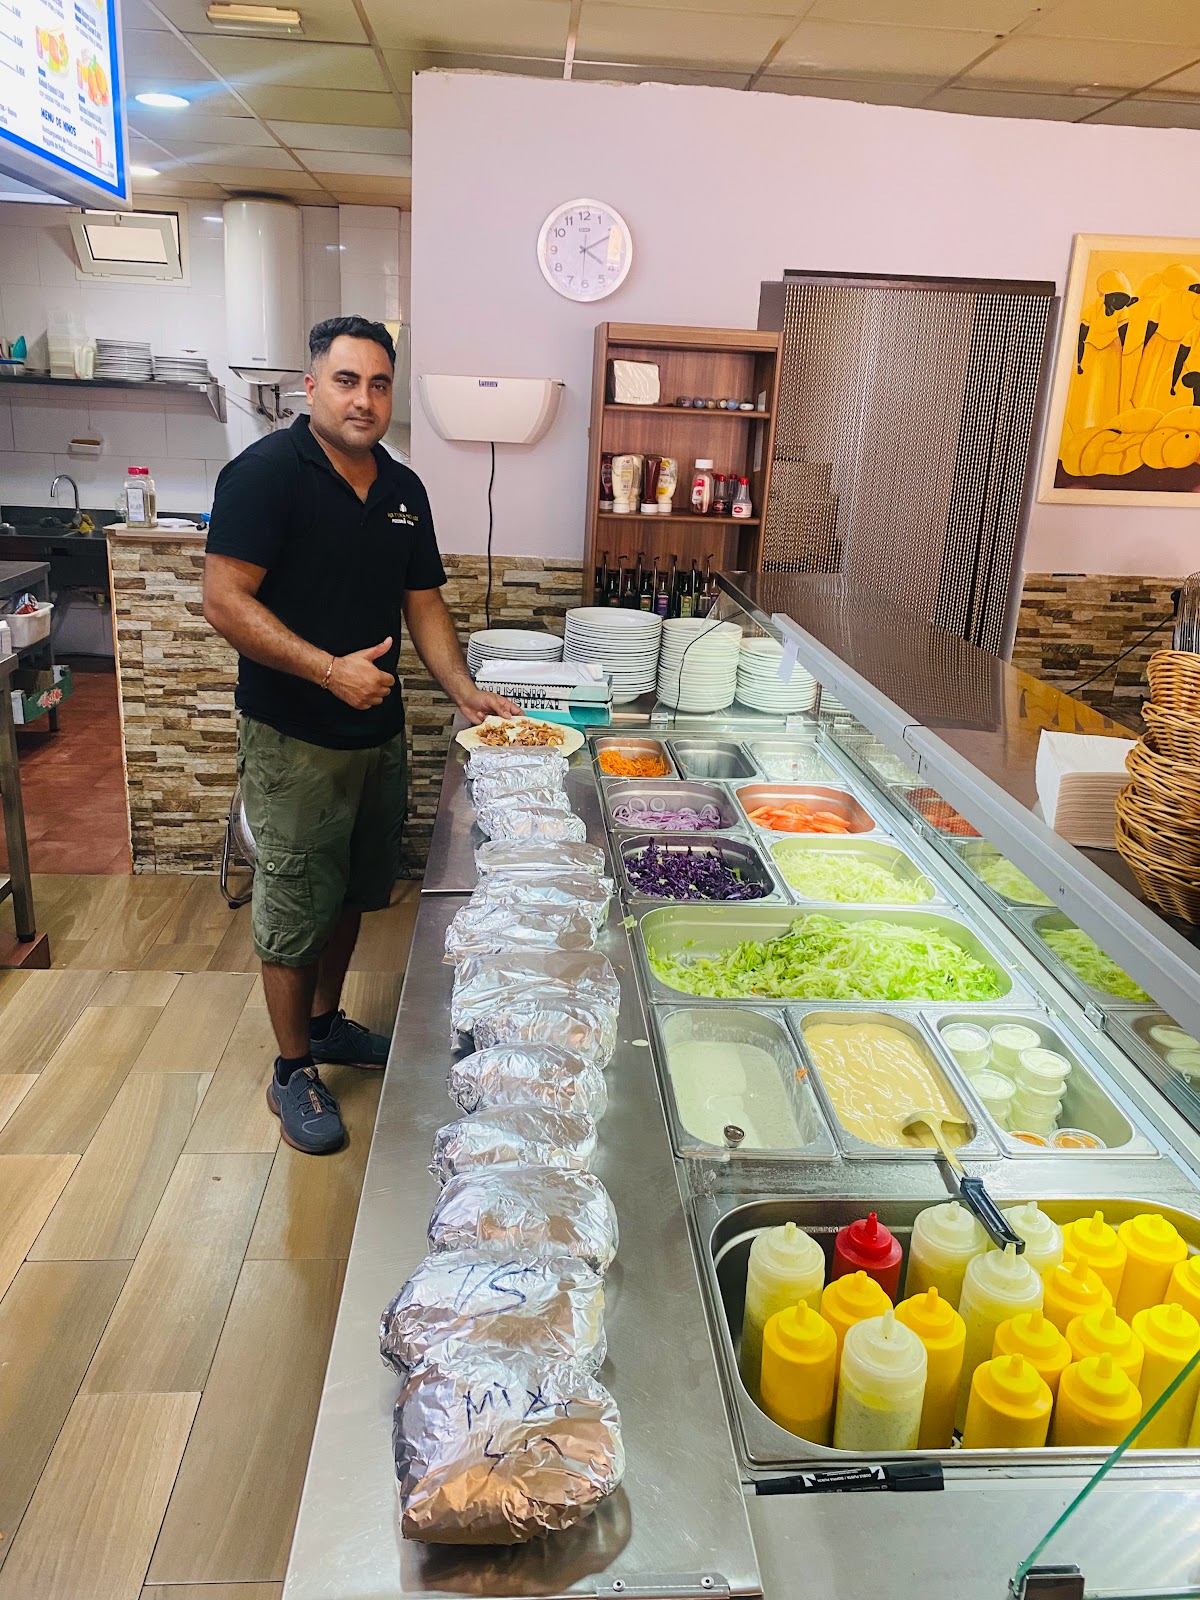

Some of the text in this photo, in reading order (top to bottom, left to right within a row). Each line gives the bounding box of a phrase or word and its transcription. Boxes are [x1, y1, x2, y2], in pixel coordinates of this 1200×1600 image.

[565, 216, 573, 225] 11
[579, 211, 591, 221] 12
[554, 228, 566, 238] 10
[550, 246, 558, 255] 9
[555, 263, 562, 272] 8
[567, 276, 574, 285] 7
[598, 275, 605, 284] 5
[581, 280, 589, 289] 6
[510, 697, 563, 711] STRIAL
